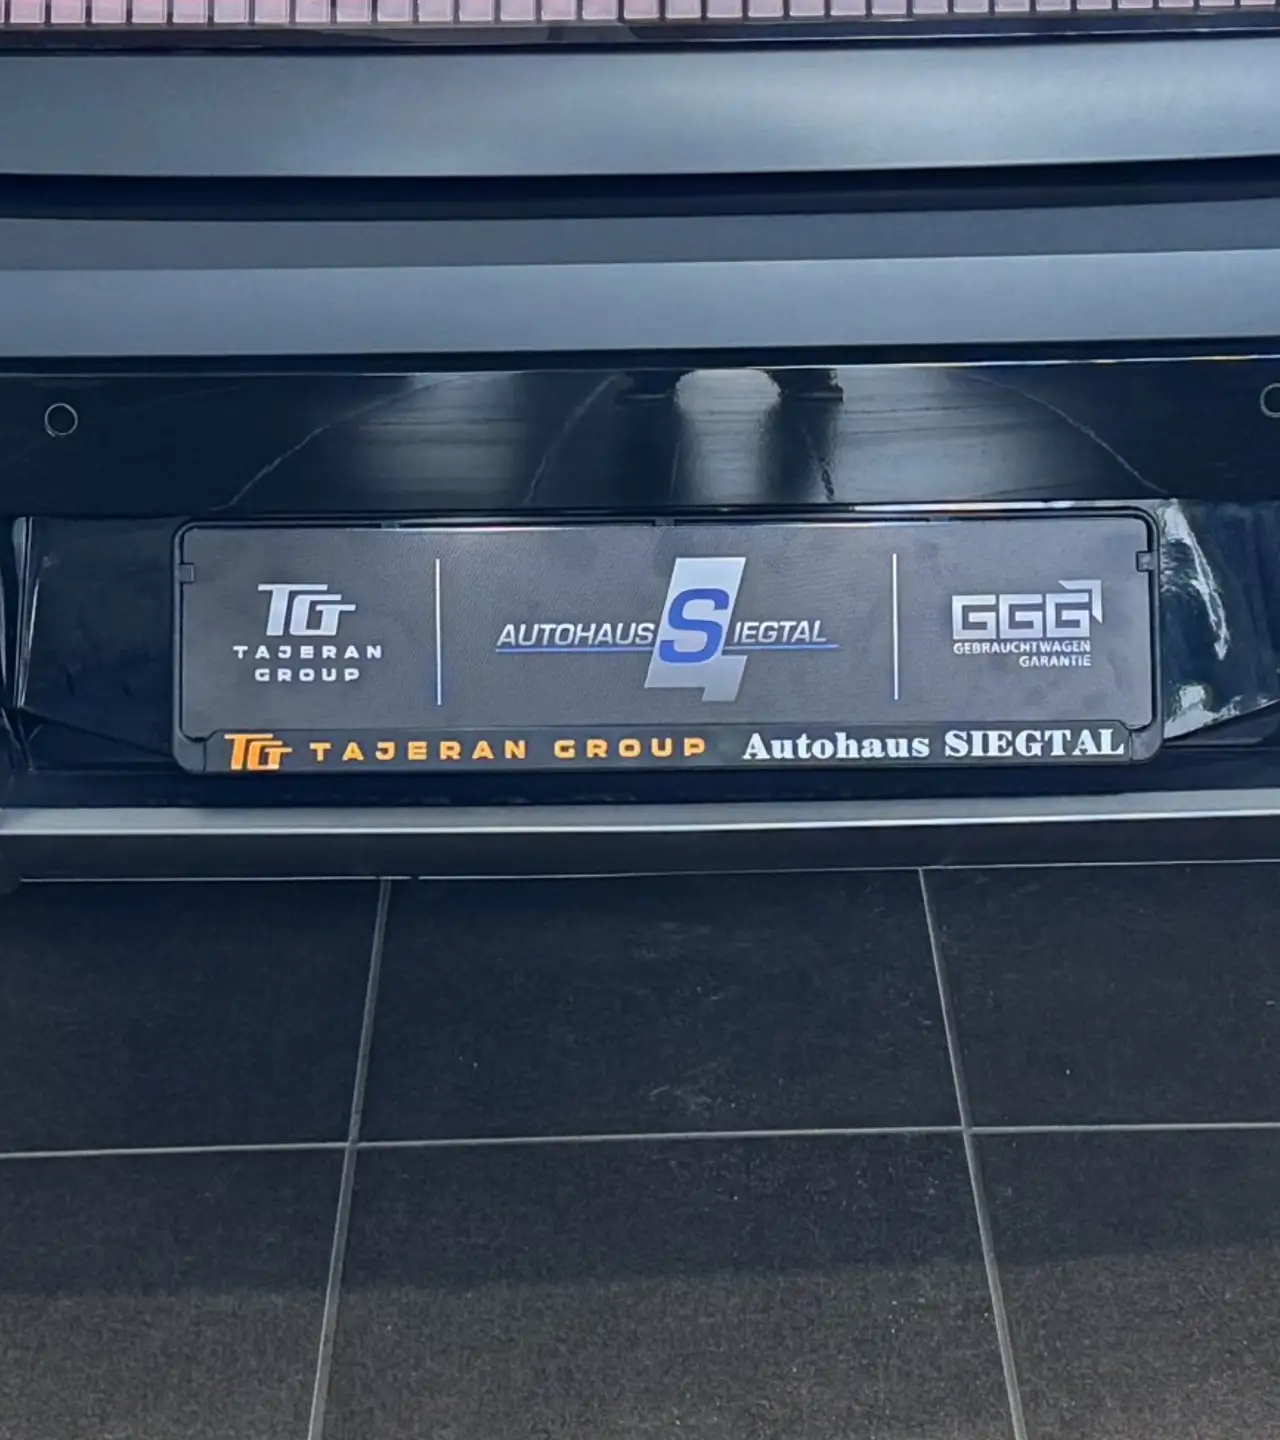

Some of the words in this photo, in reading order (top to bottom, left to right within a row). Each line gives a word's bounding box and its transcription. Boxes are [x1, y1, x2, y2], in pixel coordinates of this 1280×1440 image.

[952, 588, 1094, 640] GGG
[496, 622, 656, 647] AUTOHAUS
[233, 645, 382, 660] TAJERAN
[953, 640, 1091, 655] GEBRAUCHTWAGEN
[1018, 654, 1092, 668] GARANTIE
[254, 667, 361, 682] GROUP
[310, 740, 527, 761] TAJERAN
[554, 737, 706, 759] GROUP
[742, 732, 931, 761] Autohaus
[944, 729, 1125, 758] SIEGTAL
